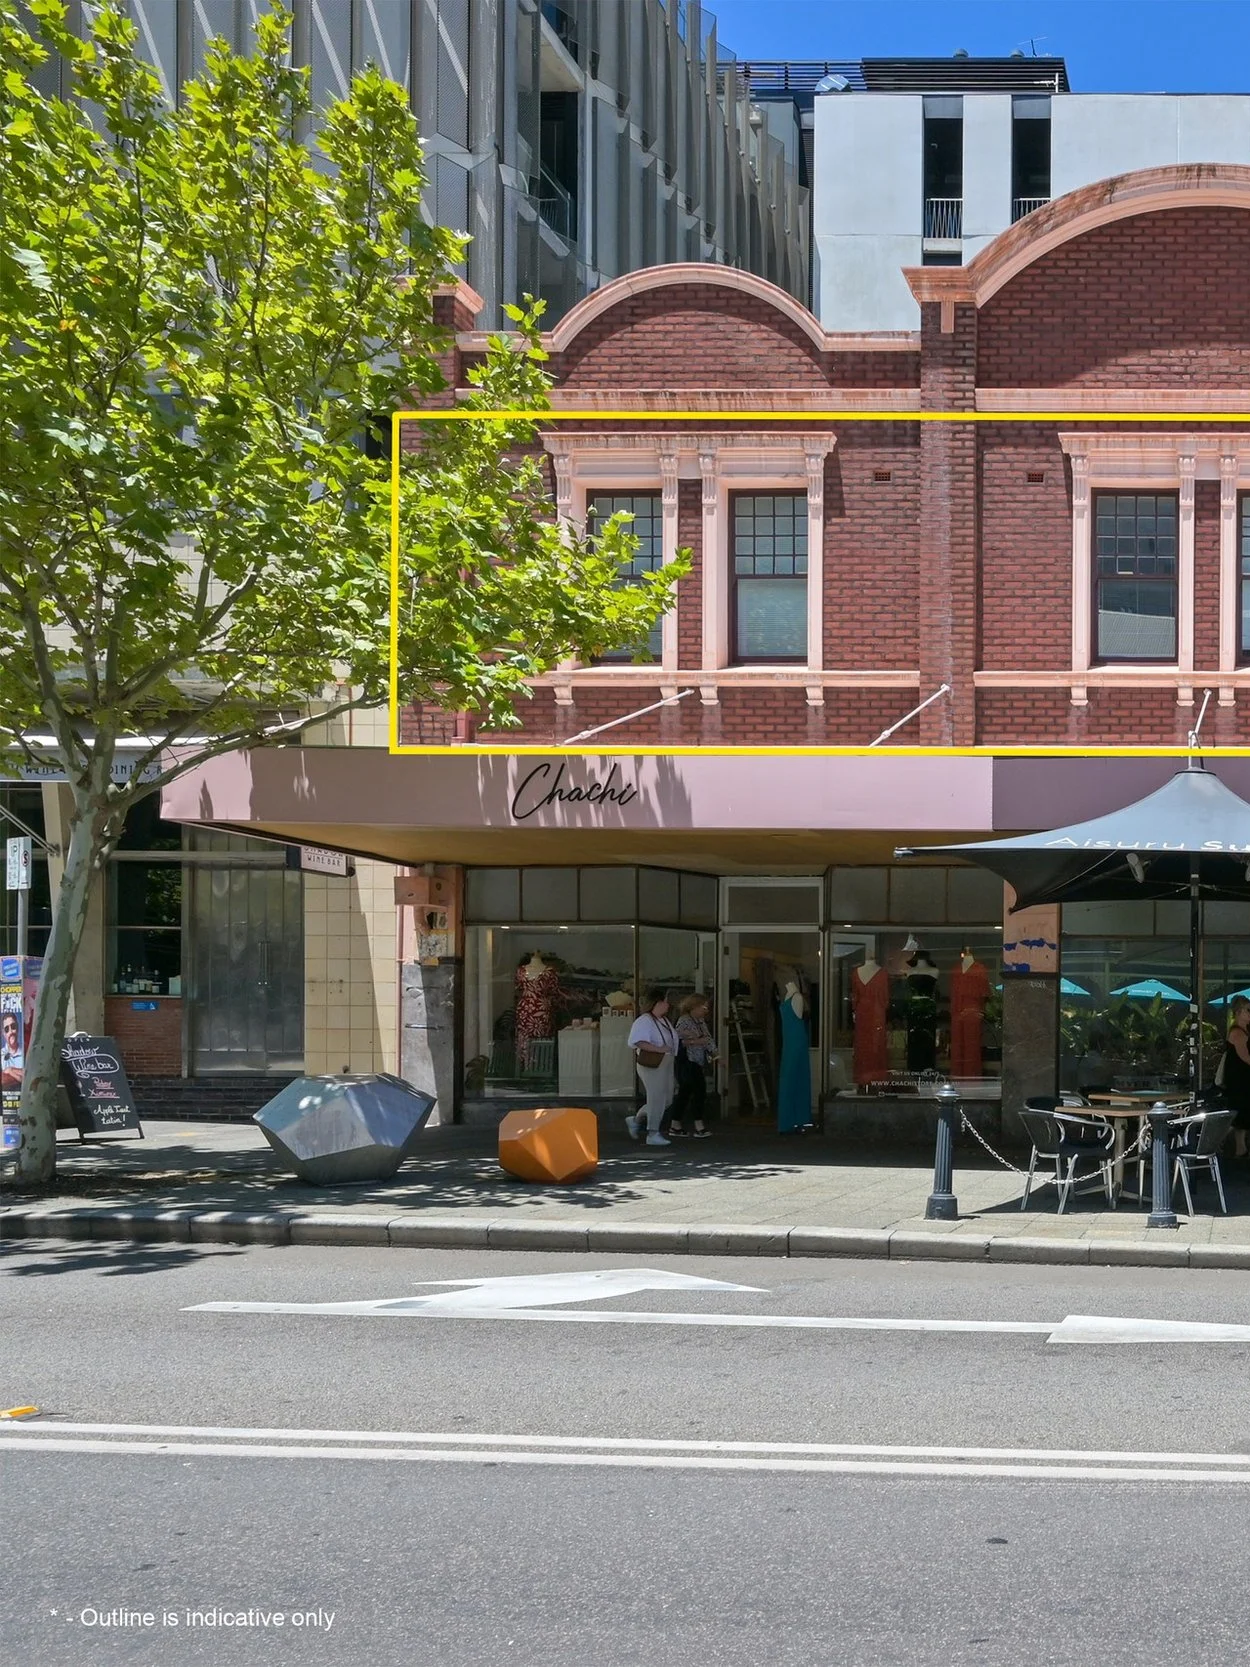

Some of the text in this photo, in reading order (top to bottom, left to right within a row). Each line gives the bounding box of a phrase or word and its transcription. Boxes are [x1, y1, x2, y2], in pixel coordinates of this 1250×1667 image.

[109, 765, 150, 775] DINIG
[512, 763, 637, 819] Chachi
[1045, 836, 1185, 849] Aisuru
[327, 858, 341, 866] BAR
[94, 1104, 114, 1116] Apple
